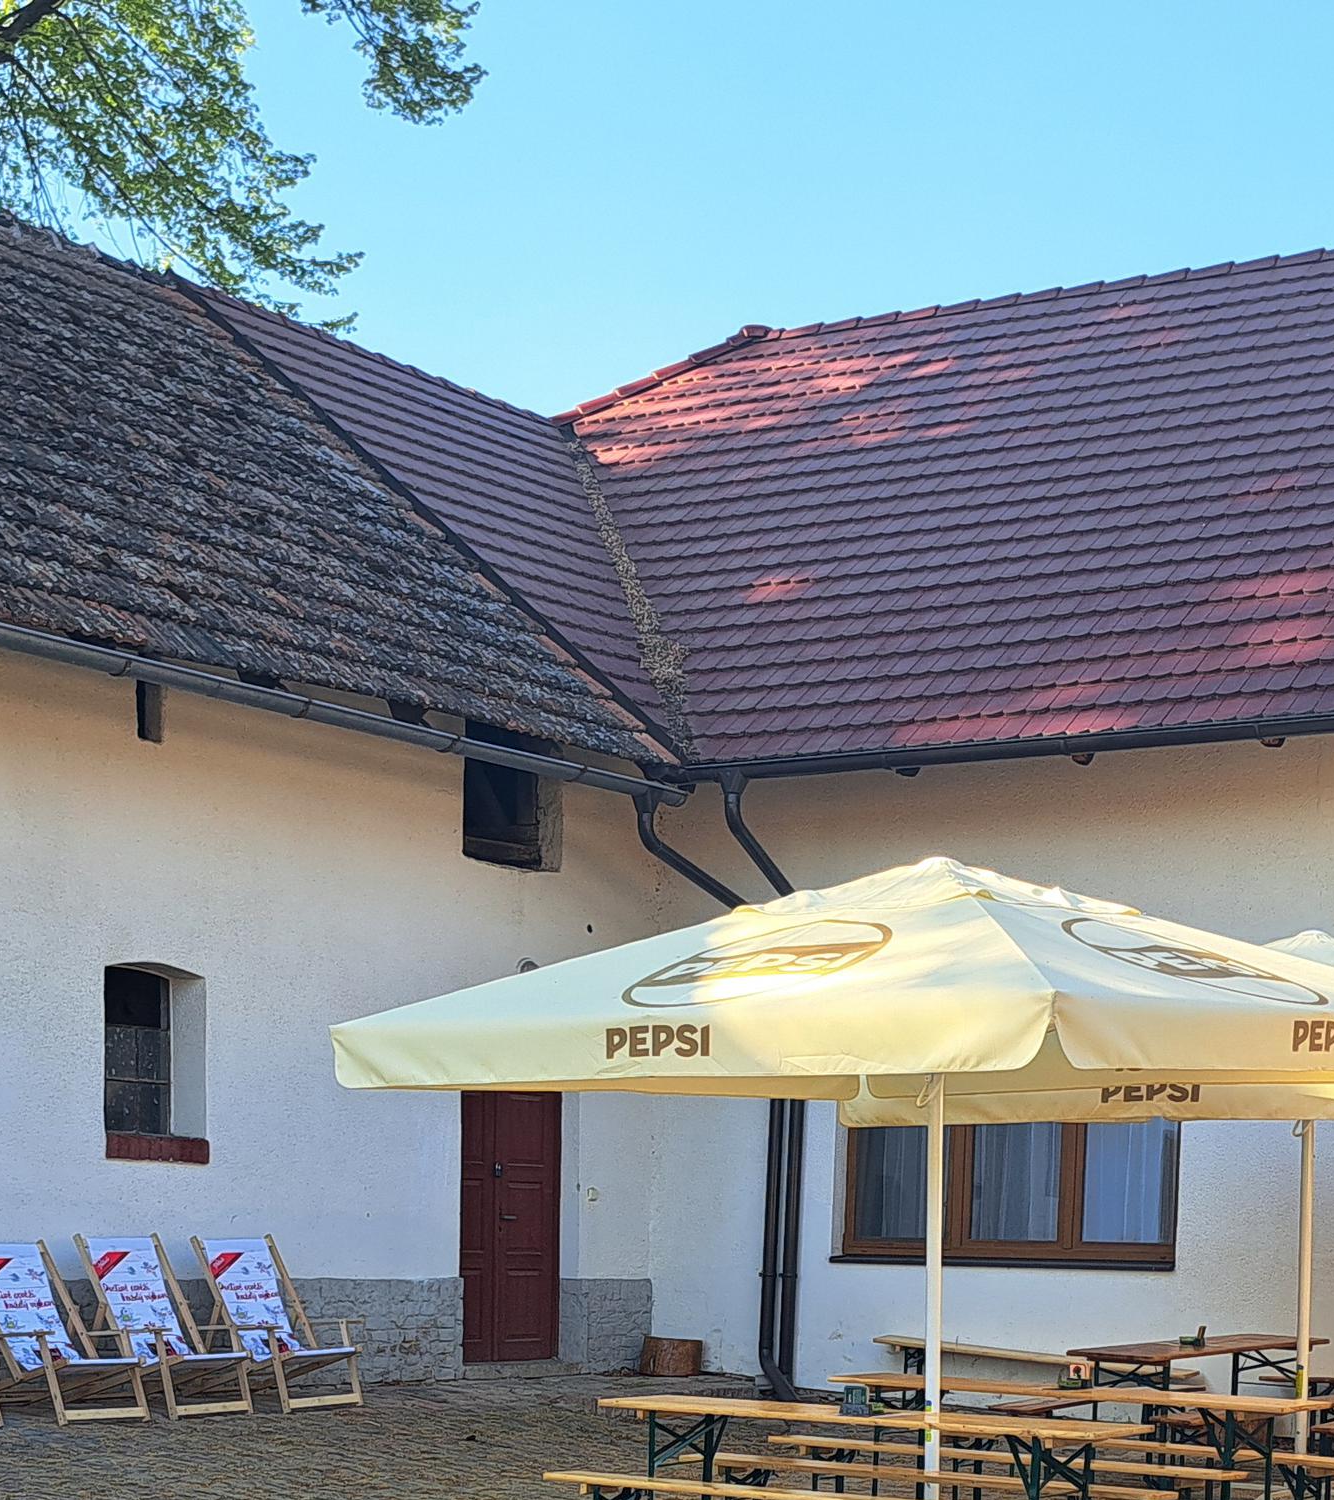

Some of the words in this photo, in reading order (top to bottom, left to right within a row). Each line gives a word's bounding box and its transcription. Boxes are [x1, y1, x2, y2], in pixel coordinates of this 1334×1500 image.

[651, 950, 865, 981] PEPSI
[605, 1024, 710, 1059] PEPSI
[1101, 1083, 1200, 1103] PEPSI
